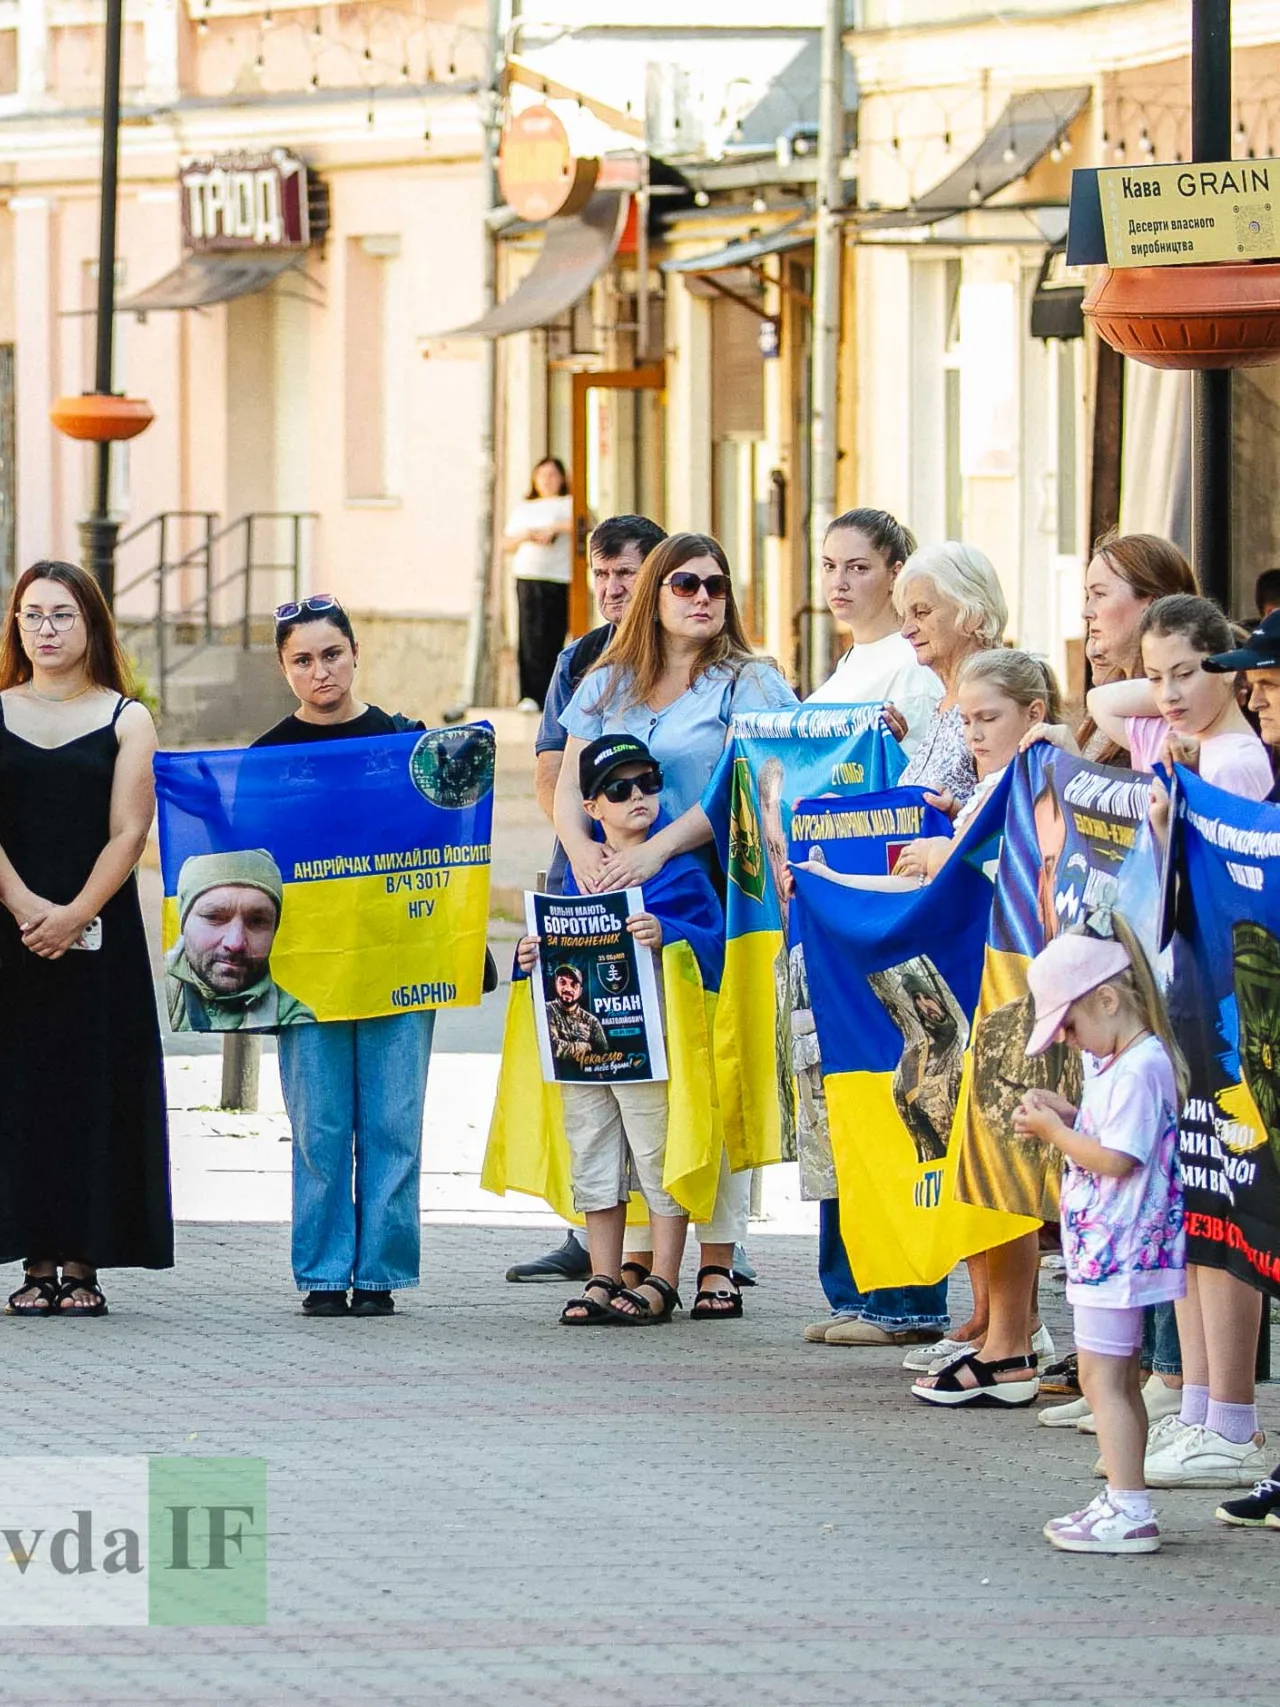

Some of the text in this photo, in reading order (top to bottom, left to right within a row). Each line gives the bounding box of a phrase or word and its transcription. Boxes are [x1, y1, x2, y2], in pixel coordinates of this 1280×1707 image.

[1122, 168, 1270, 199] Кава GRAIN
[1128, 217, 1215, 236] Десерти власного
[1131, 239, 1194, 259] виробництва
[293, 855, 371, 879] АНДРІЙЧАК
[374, 848, 441, 873] МИХАЙЛО
[386, 871, 450, 893] В/Ч 3017
[408, 899, 435, 920] НГУ
[574, 904, 606, 917] МАЮТЬ
[543, 913, 622, 935] БОРОТИСЬ
[547, 932, 621, 947] ЗА ПОЛОНЕНИХ
[391, 982, 457, 1008] «БАРНІ»
[593, 995, 642, 1013] РУБАН
[1180, 1130, 1208, 1156] МИ
[1180, 1163, 1207, 1189] МИ
